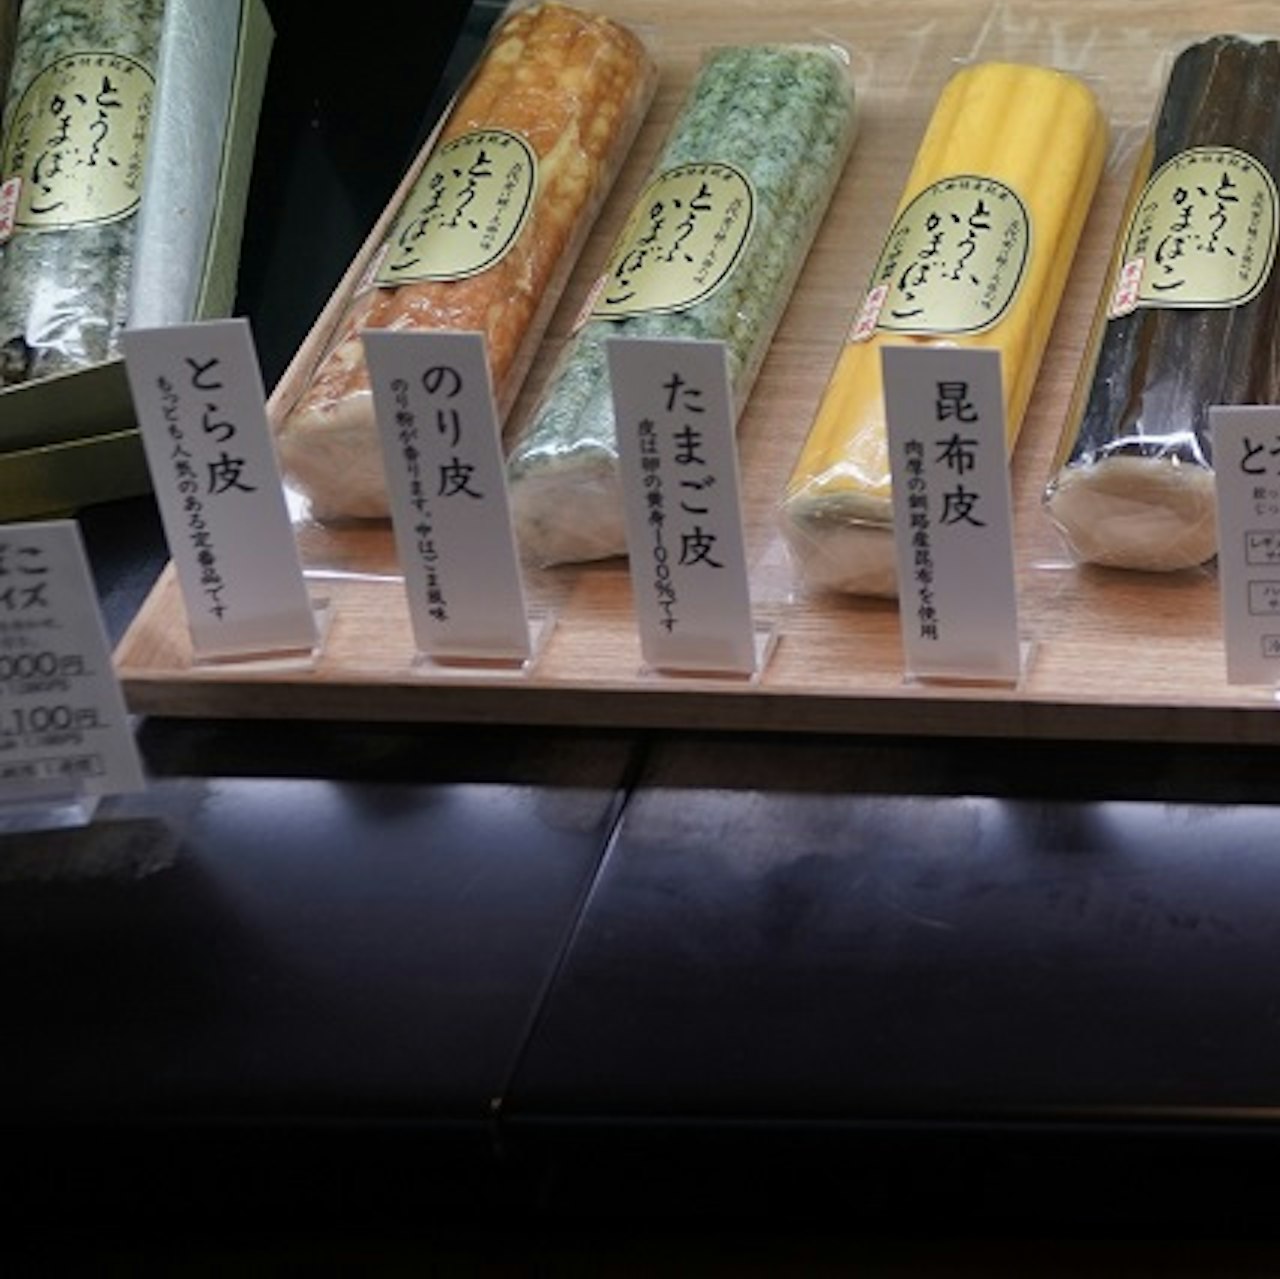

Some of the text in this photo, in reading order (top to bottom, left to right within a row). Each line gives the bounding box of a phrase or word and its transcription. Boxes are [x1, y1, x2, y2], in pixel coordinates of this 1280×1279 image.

[184, 356, 258, 496] とら皮
[420, 364, 484, 501] のり皮
[662, 372, 725, 570] たまご皮
[935, 381, 988, 528] 昆布皮
